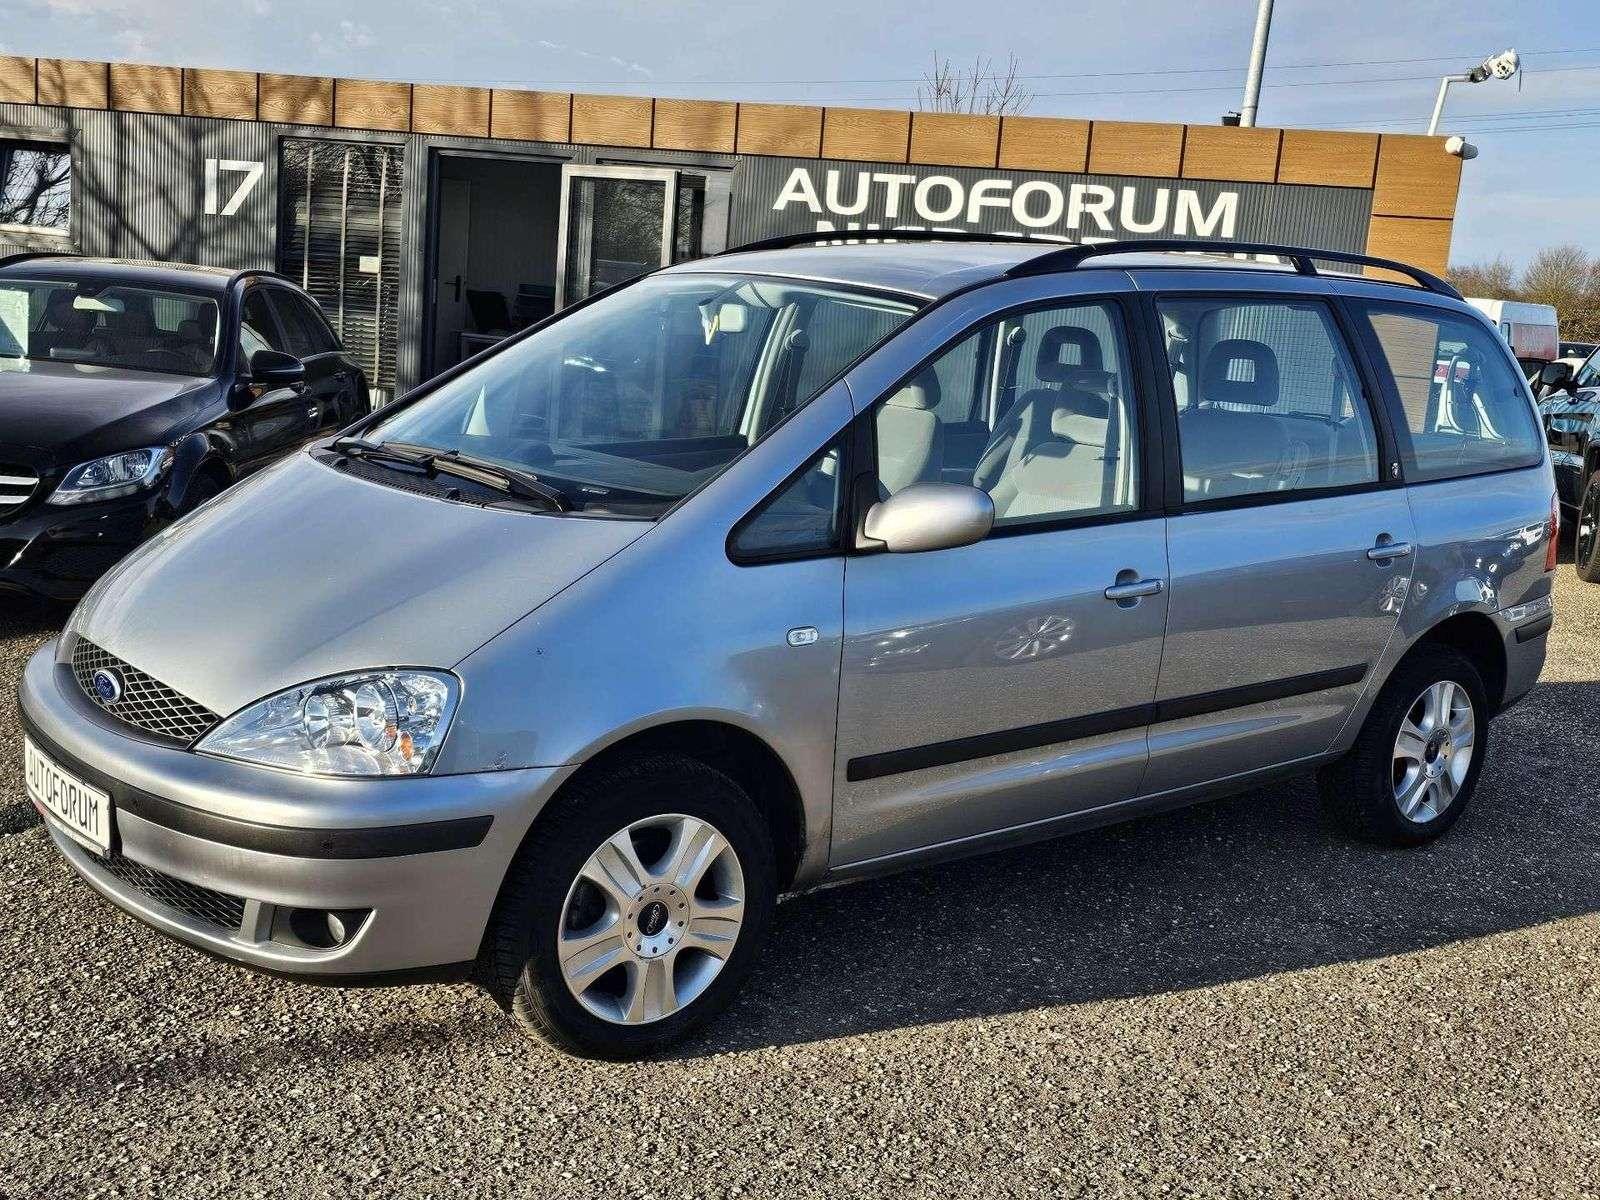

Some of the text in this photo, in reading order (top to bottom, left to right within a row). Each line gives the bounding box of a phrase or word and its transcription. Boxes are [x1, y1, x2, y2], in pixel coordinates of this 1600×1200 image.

[205, 159, 264, 215] 17
[773, 167, 1239, 237] AUTOFORUM
[28, 748, 99, 836] AUTOFORUM
